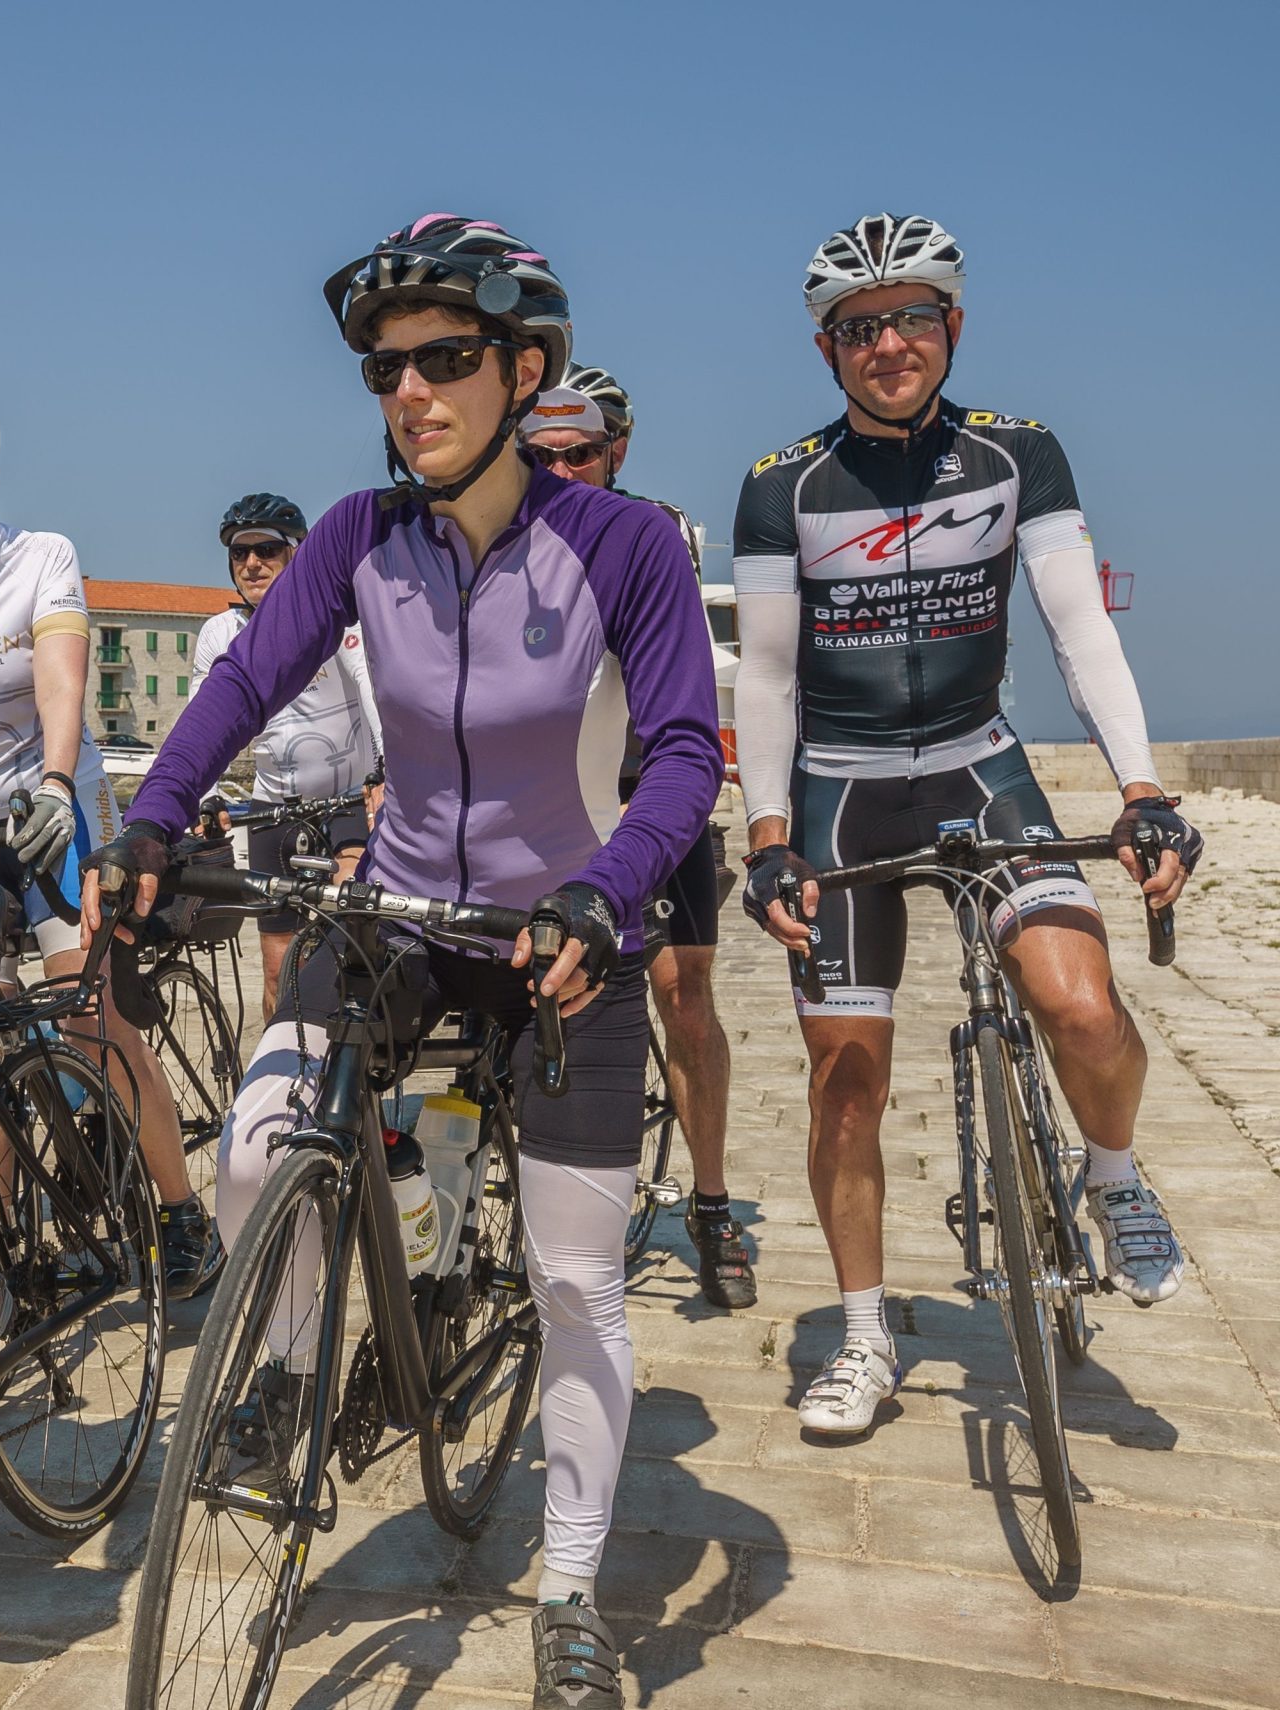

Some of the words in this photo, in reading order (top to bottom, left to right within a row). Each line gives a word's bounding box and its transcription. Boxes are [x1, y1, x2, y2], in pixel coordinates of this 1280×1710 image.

[861, 578, 934, 600] Valley
[937, 567, 986, 590] First
[815, 586, 996, 620] GRANFONDO
[815, 632, 907, 647] OKANAGAN
